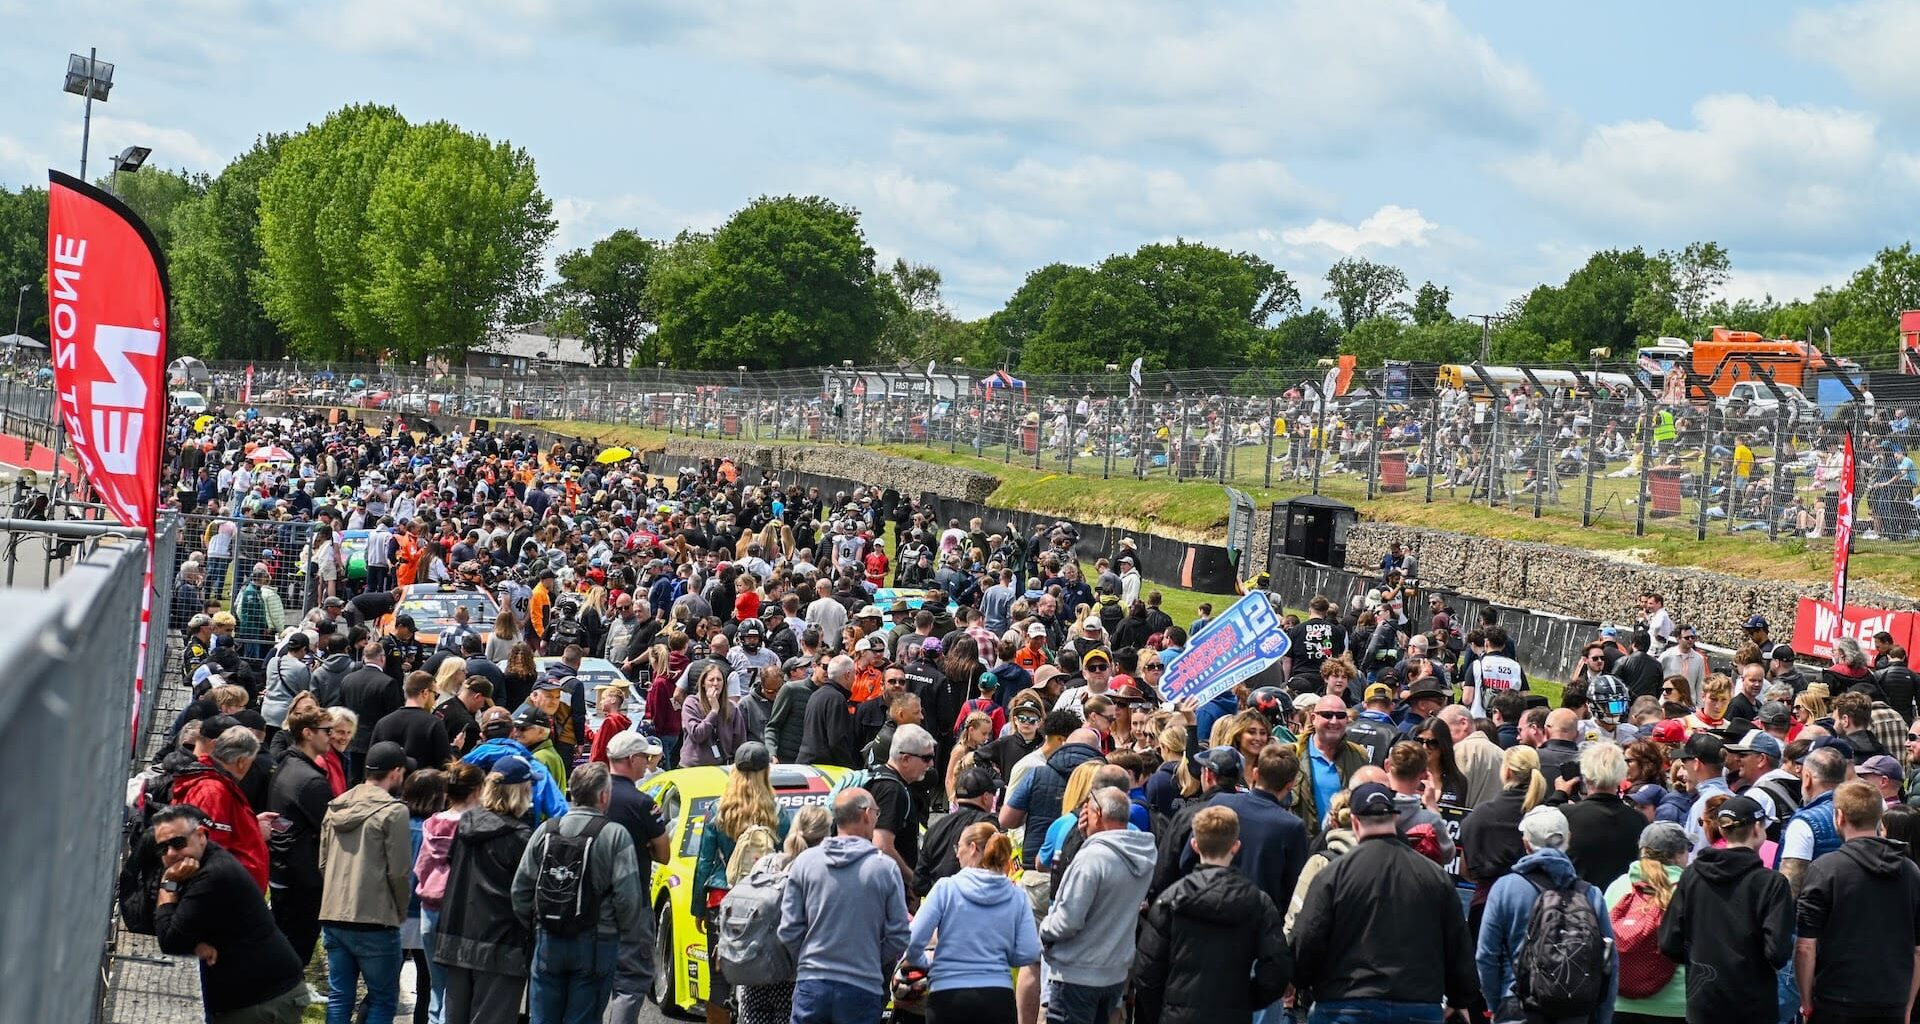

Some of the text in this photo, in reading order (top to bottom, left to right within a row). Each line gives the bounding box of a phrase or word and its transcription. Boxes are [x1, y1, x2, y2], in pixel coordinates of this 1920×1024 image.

[895, 381, 925, 391] FAST ANE
[515, 597, 529, 612] 49
[1231, 598, 1275, 644] 12
[1306, 624, 1332, 632] BOYS
[1177, 623, 1237, 673] AMERICAN
[1170, 635, 1239, 693] SPEEDFEST
[904, 673, 934, 684] ETRONAS
[1483, 678, 1510, 689] MEDIA
[774, 795, 829, 807] ASCA
